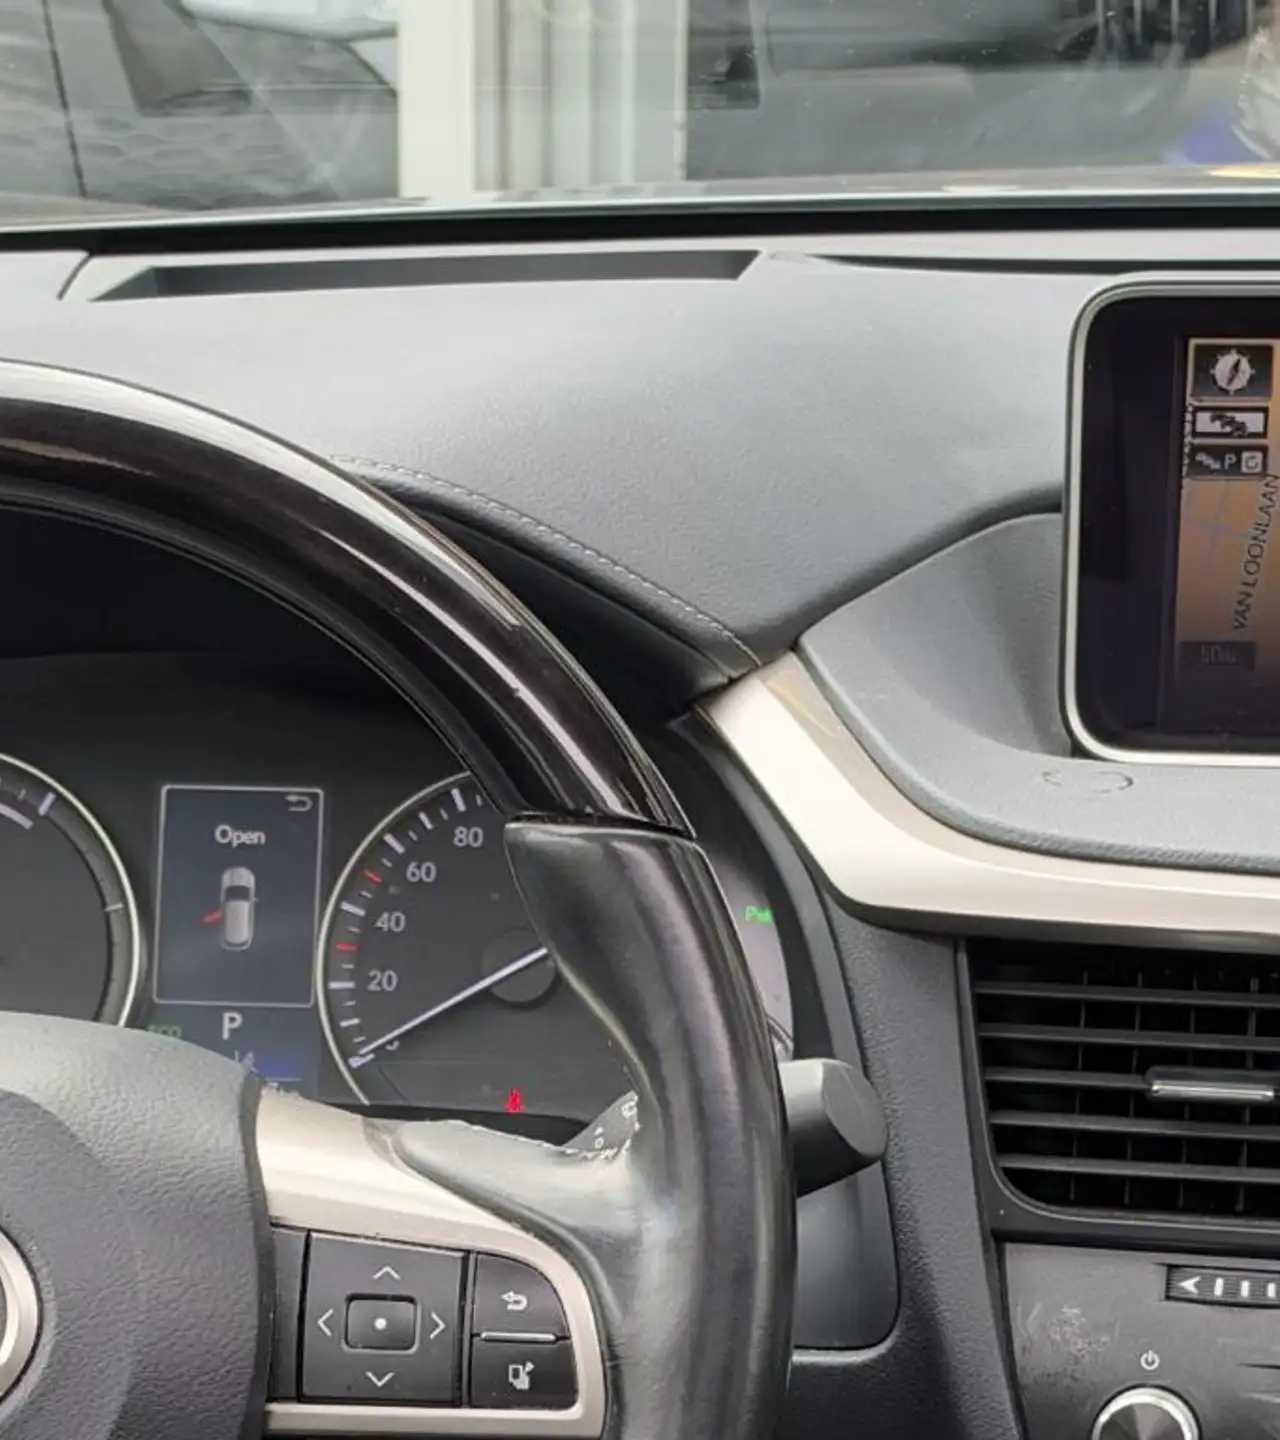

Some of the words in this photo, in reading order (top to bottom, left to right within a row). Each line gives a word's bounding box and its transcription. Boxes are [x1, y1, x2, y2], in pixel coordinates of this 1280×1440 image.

[1233, 592, 1253, 630] VAN
[1243, 473, 1280, 589] LOONLAAN
[215, 825, 265, 846] Open
[453, 827, 483, 847] 80
[406, 862, 436, 883] 60
[375, 912, 406, 933] 40
[367, 970, 398, 992] 20
[221, 1011, 244, 1041] P
